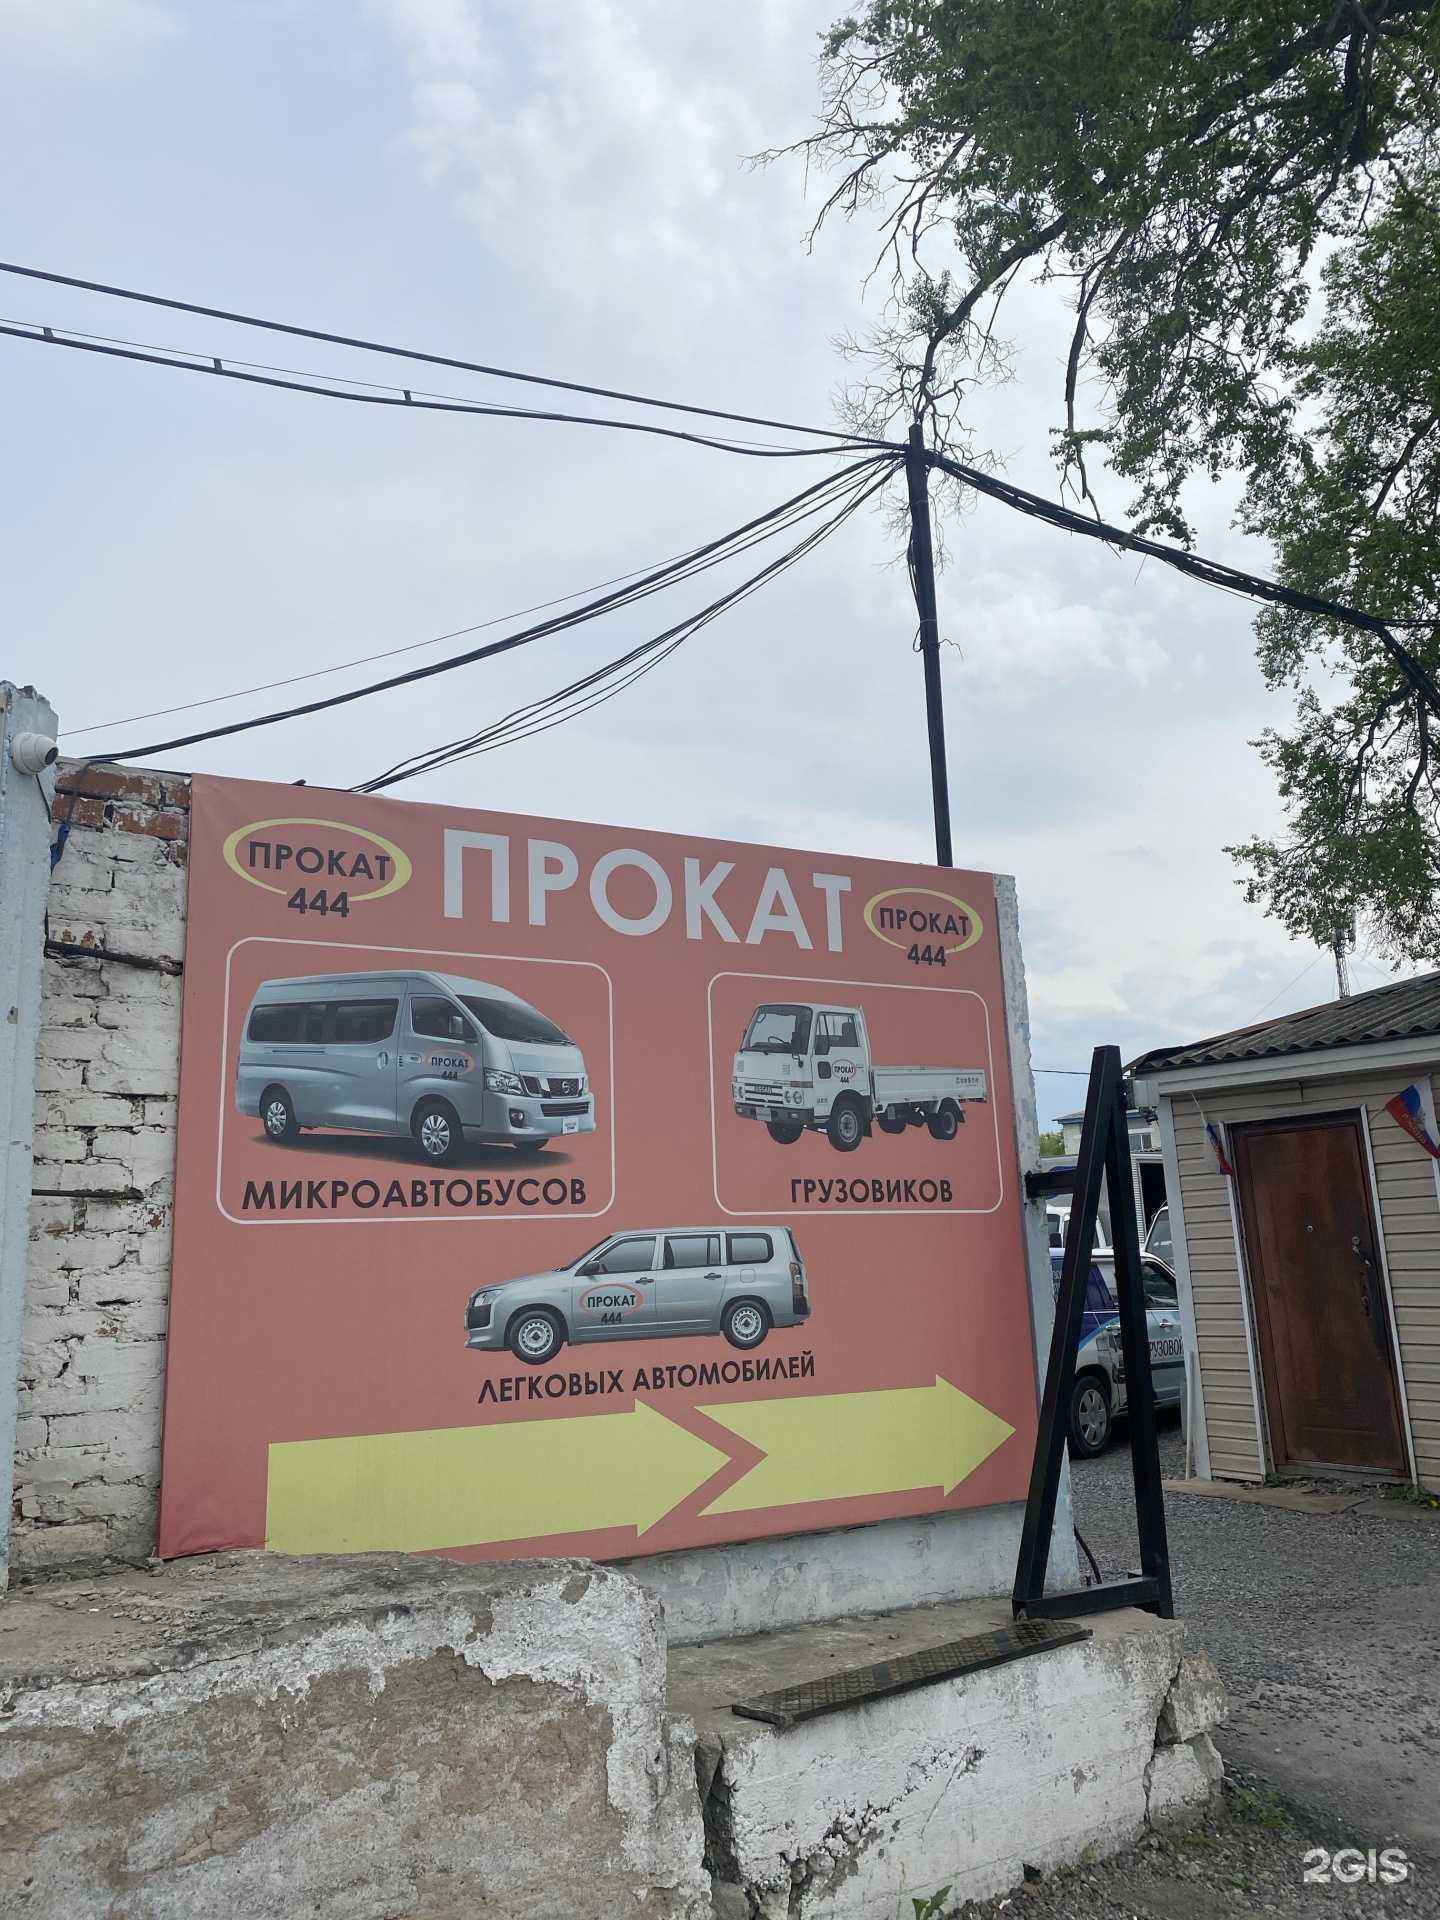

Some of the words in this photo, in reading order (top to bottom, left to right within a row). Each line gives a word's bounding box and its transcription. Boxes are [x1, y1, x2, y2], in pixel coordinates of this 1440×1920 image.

[249, 841, 390, 882] ПРОКАТ
[287, 887, 350, 918] 444
[442, 829, 851, 953] ПРОКАТ
[879, 907, 970, 937] ПРОКАТ
[907, 943, 947, 967] 444
[431, 1056, 468, 1068] ПРОКАТ
[242, 1178, 587, 1210] МИКРОАВТОБУСОВ
[790, 1178, 953, 1204] ГРУЗОВИКОВ
[587, 1294, 636, 1308] ПРОКАТ
[601, 1311, 623, 1325] 444
[478, 1369, 624, 1404] ЛЕГКОВЫХ
[632, 1350, 815, 1391] АВТОМОБИЛЕЙ
